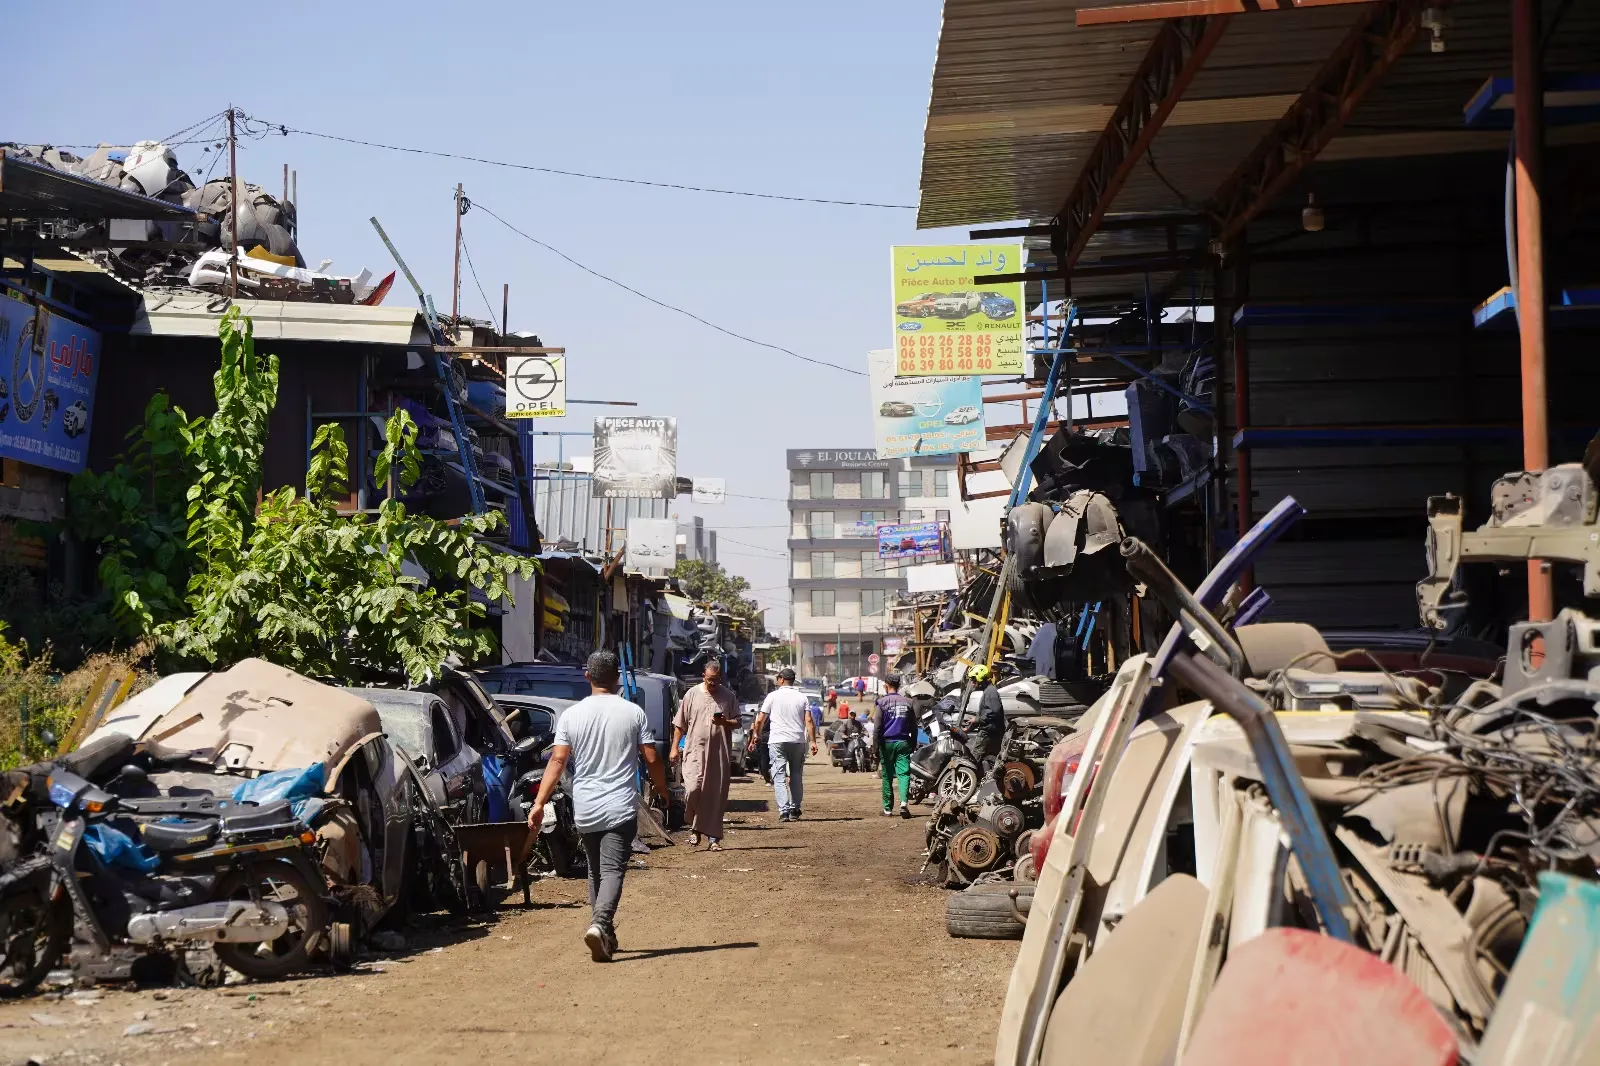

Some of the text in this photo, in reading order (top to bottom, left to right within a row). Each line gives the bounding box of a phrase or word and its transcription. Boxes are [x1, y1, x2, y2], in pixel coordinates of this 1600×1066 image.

[906, 249, 1007, 273] ولد لحسن
[931, 277, 956, 286] Auto
[900, 335, 992, 347] 06 02 26 28 45
[996, 333, 1022, 345] المهدي
[900, 346, 991, 359] 06 89 12 58 89
[900, 359, 992, 371] 06 39 80 40 40
[998, 359, 1023, 369] رشيد
[516, 402, 557, 411] OPEL
[605, 418, 665, 427] PIECE AUTO
[818, 452, 832, 461] EL
